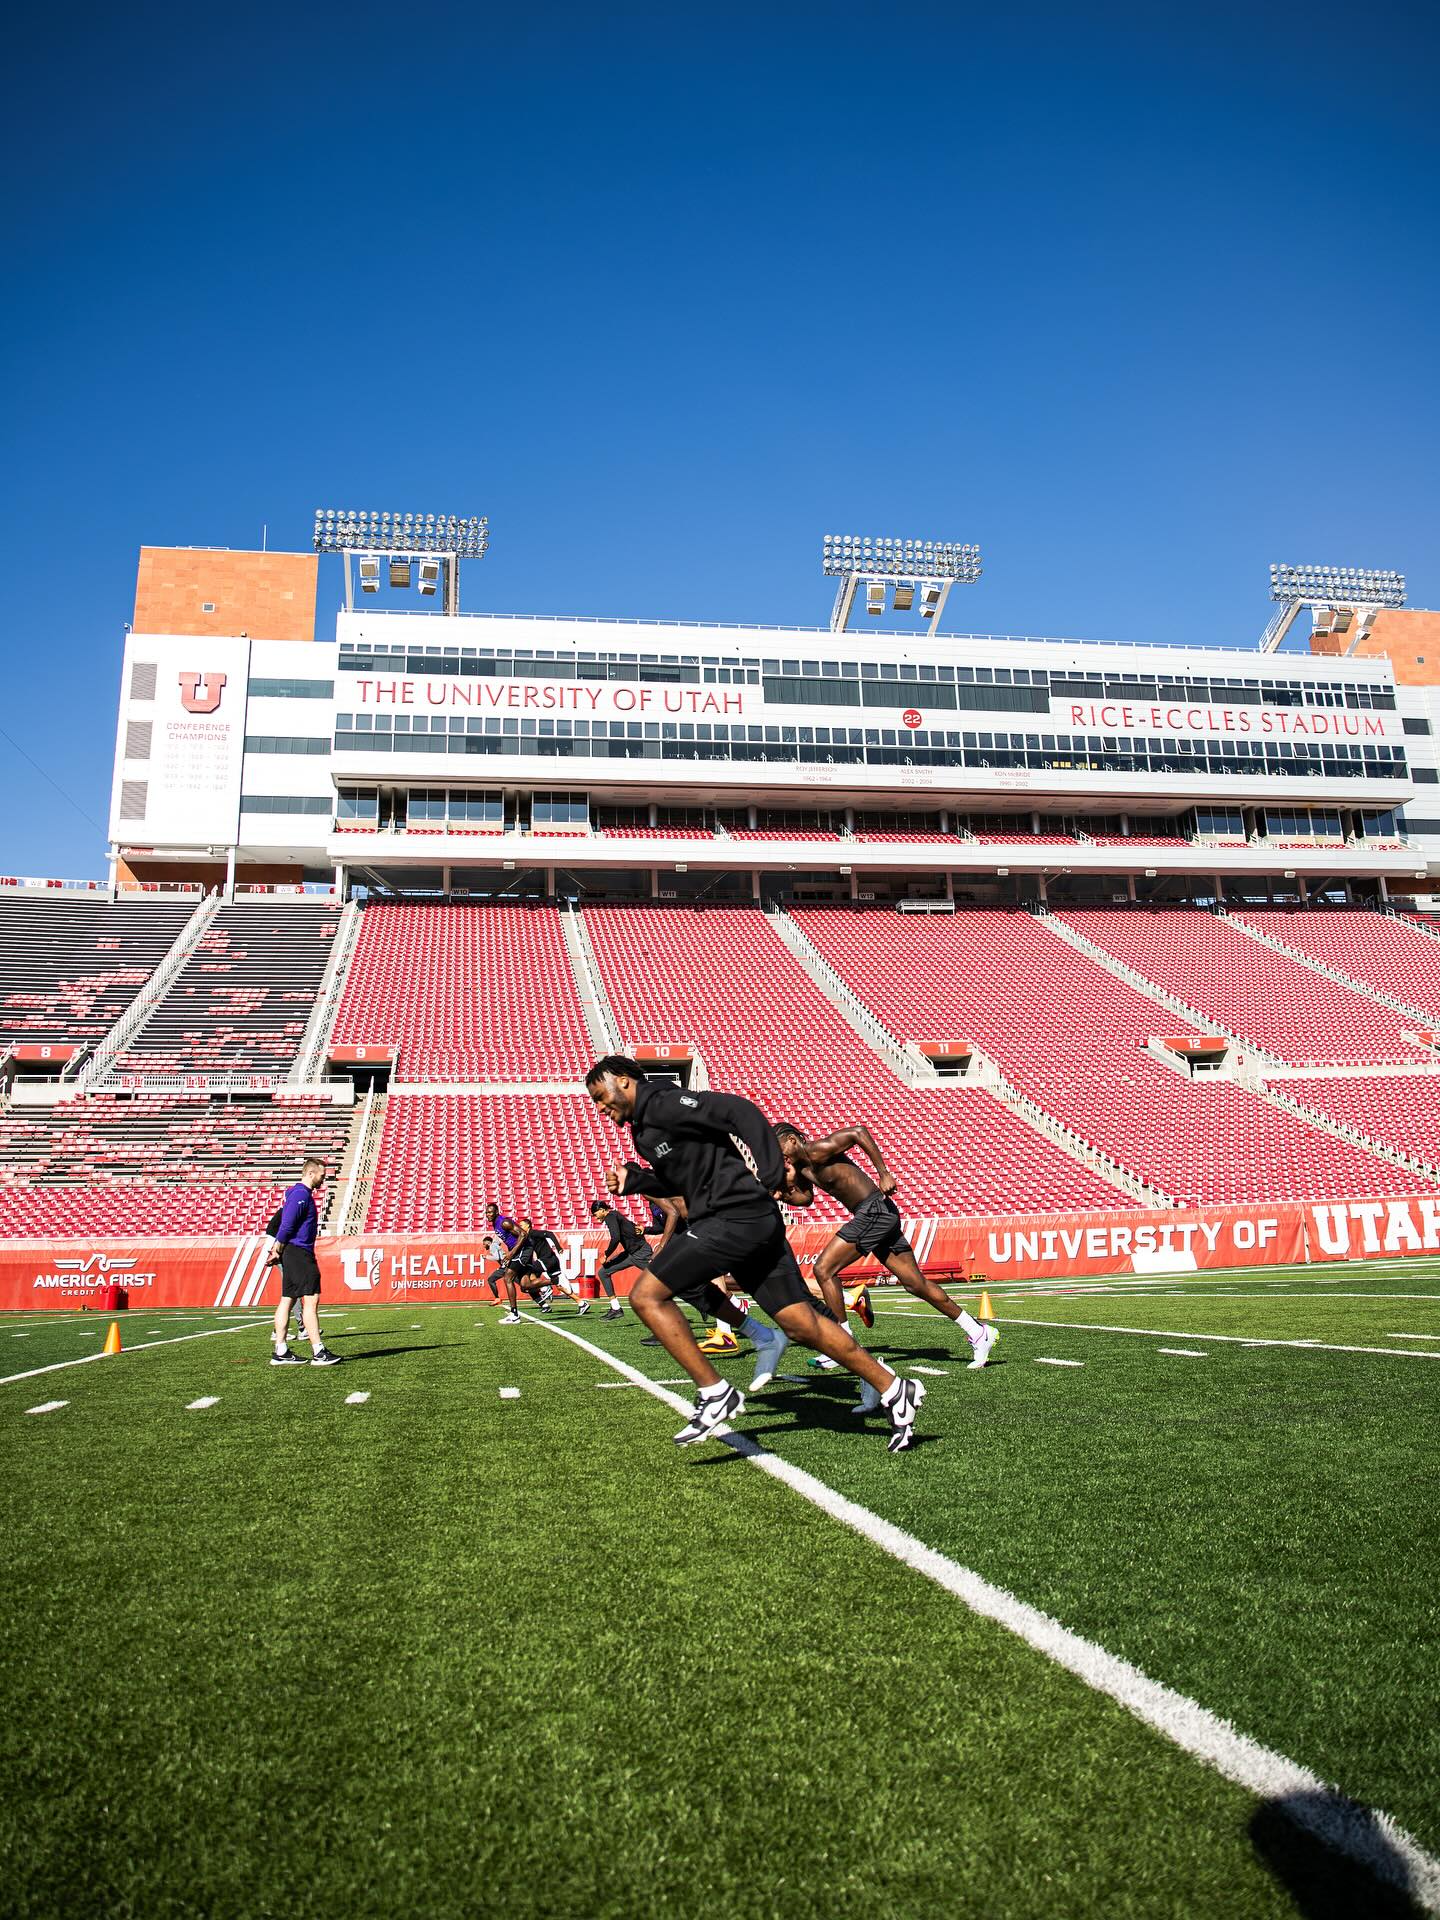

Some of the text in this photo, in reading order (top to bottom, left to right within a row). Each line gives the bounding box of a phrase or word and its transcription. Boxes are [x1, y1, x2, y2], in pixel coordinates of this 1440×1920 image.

[178, 671, 228, 714] U
[356, 681, 743, 714] THE UNIVERSITY OF UTAH
[904, 714, 921, 724] 22
[1071, 705, 1385, 736] RICE-ECCLES STADIUM
[166, 722, 231, 732] CONFERENCE
[168, 732, 227, 741] CHAMPIONS
[938, 1043, 950, 1053] 11
[1187, 1039, 1202, 1048] 12
[41, 1047, 51, 1058] 8
[355, 1047, 366, 1059] 9
[655, 1046, 670, 1057] 10
[988, 1222, 1222, 1263] UNIVERSITY
[1233, 1218, 1278, 1249] OF
[391, 1254, 485, 1276] HEALTH
[33, 1273, 157, 1288] AMERICA FIRST
[391, 1279, 485, 1290] UNIVERSITY OF UTAH
